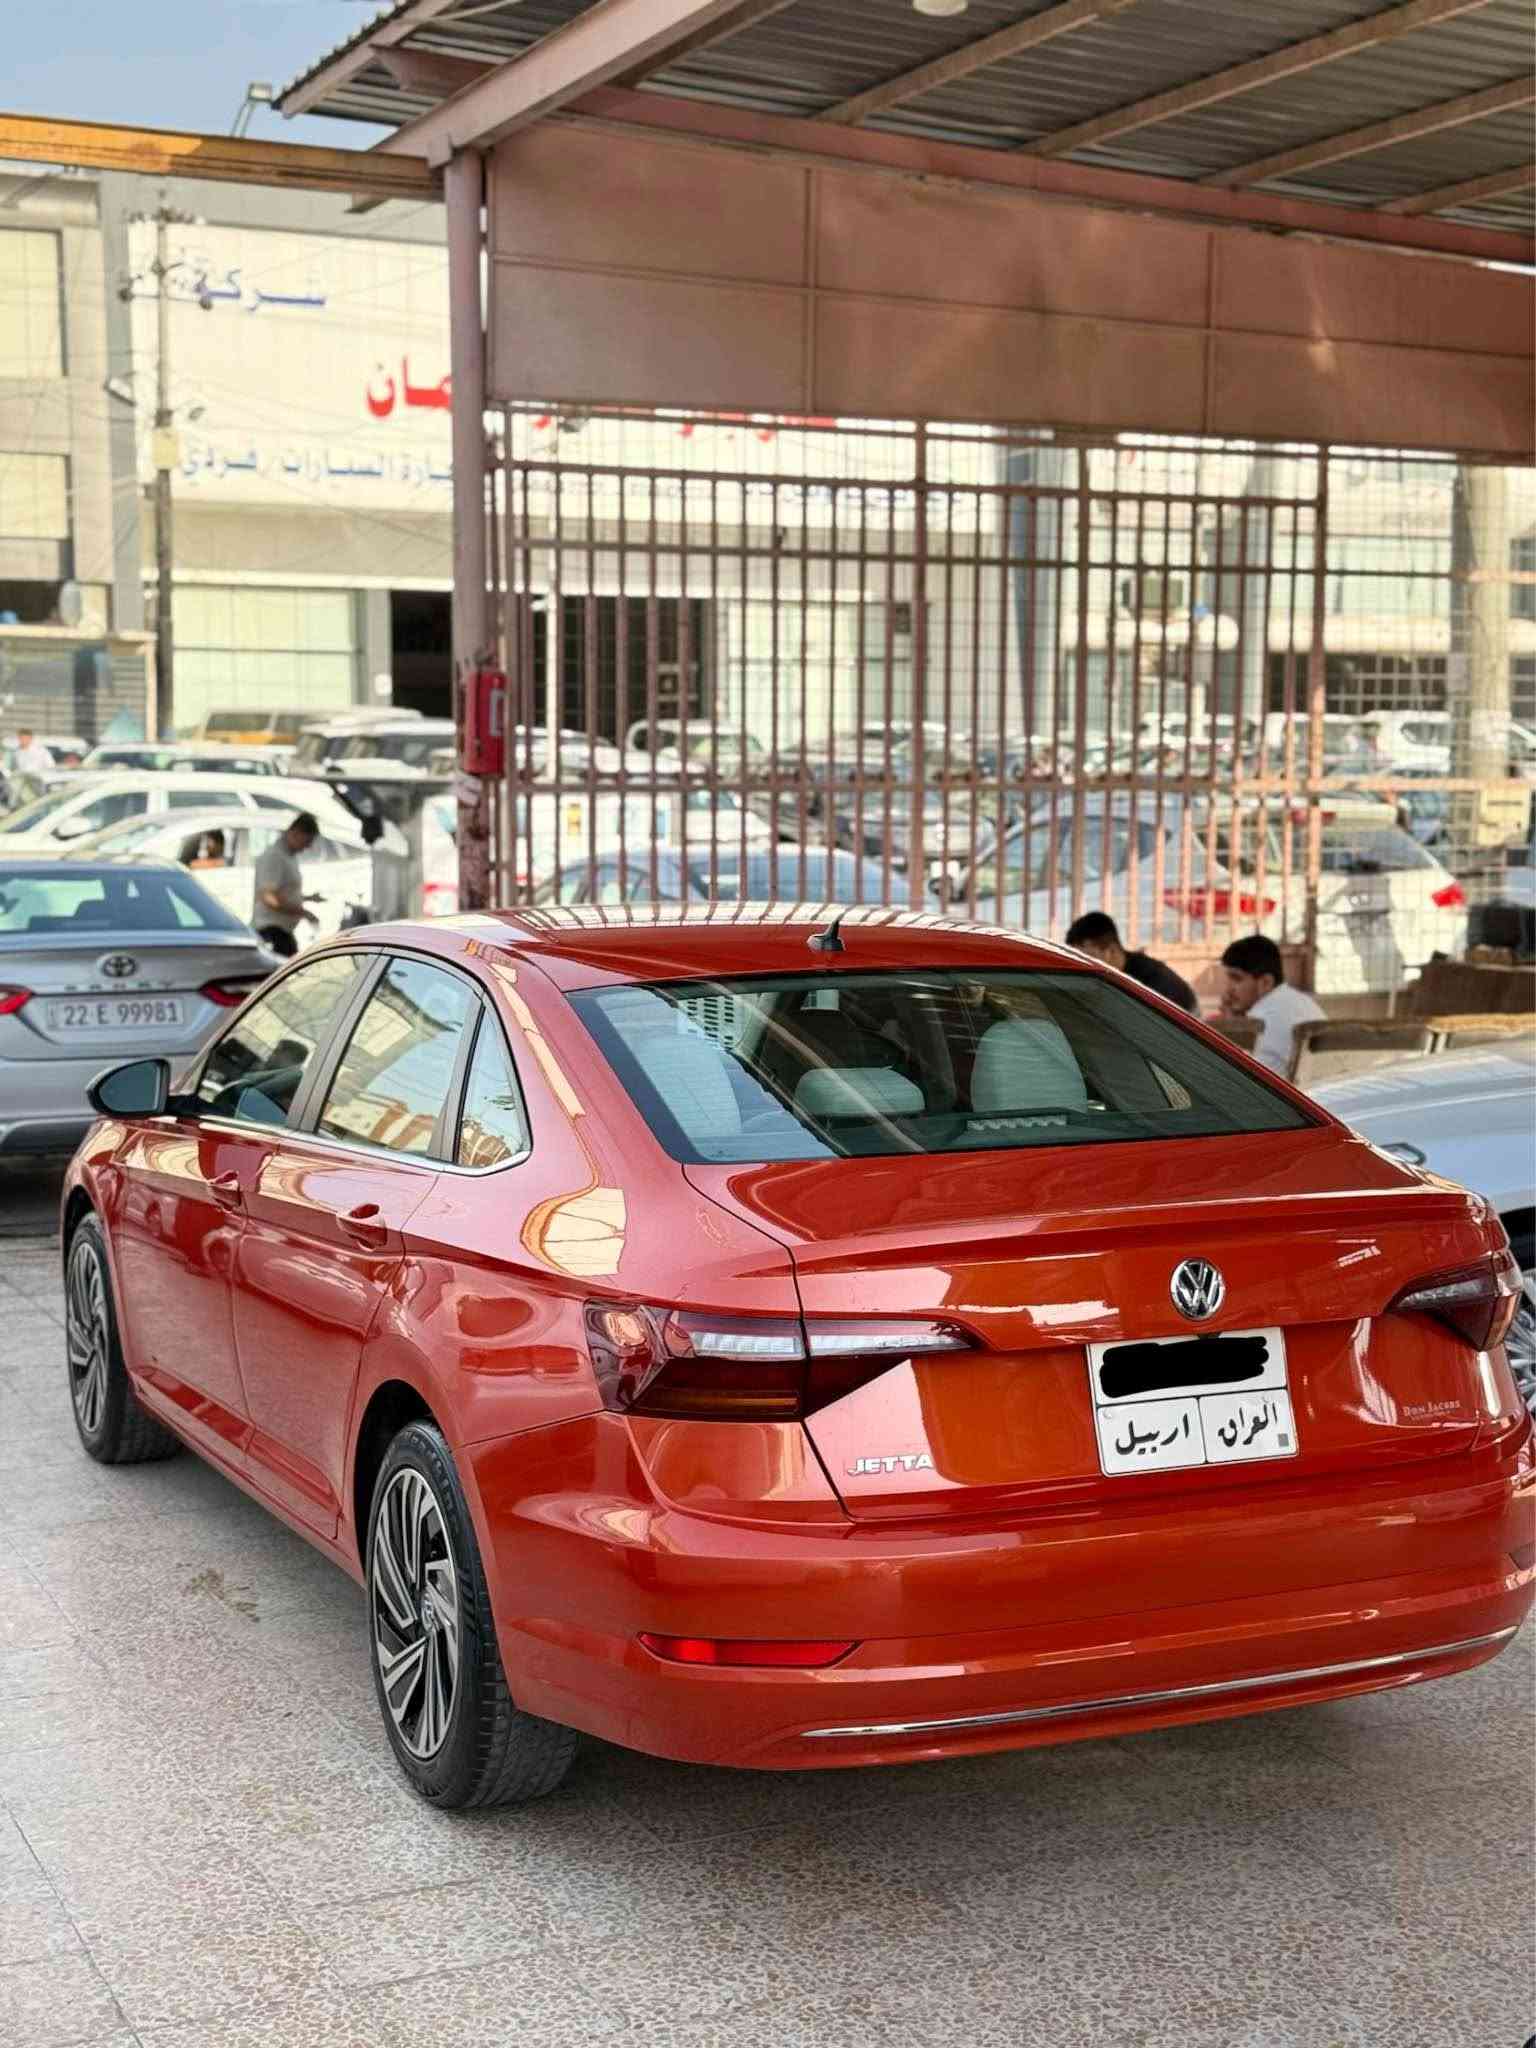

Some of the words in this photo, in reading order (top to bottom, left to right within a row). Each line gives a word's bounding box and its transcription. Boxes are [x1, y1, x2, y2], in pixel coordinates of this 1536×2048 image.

[64, 1004, 89, 1025] 22
[97, 1002, 110, 1025] E
[847, 1454, 934, 1476] JETTA
